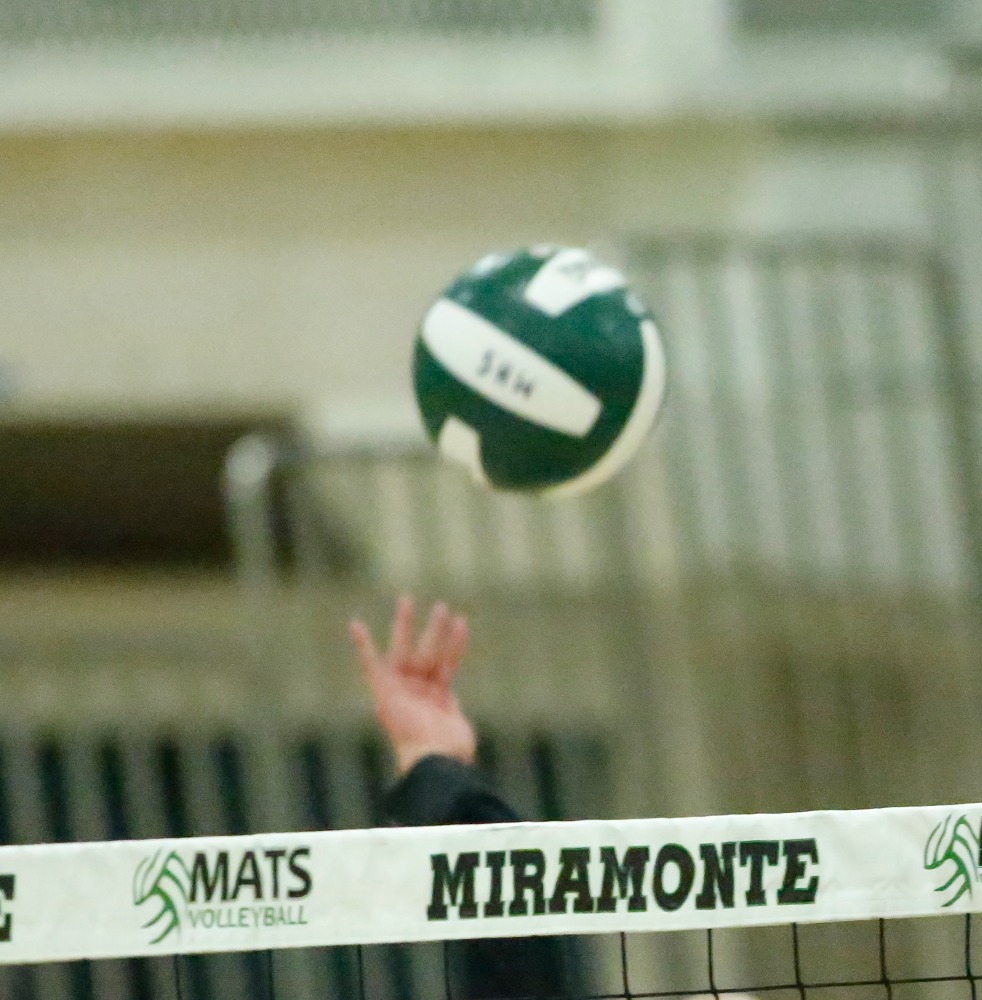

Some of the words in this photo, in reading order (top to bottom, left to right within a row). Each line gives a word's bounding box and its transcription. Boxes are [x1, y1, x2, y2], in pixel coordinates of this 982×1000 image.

[190, 847, 312, 901] MATS
[427, 838, 819, 921] MIRAMONTE
[188, 905, 307, 928] VOLLEYBALL
